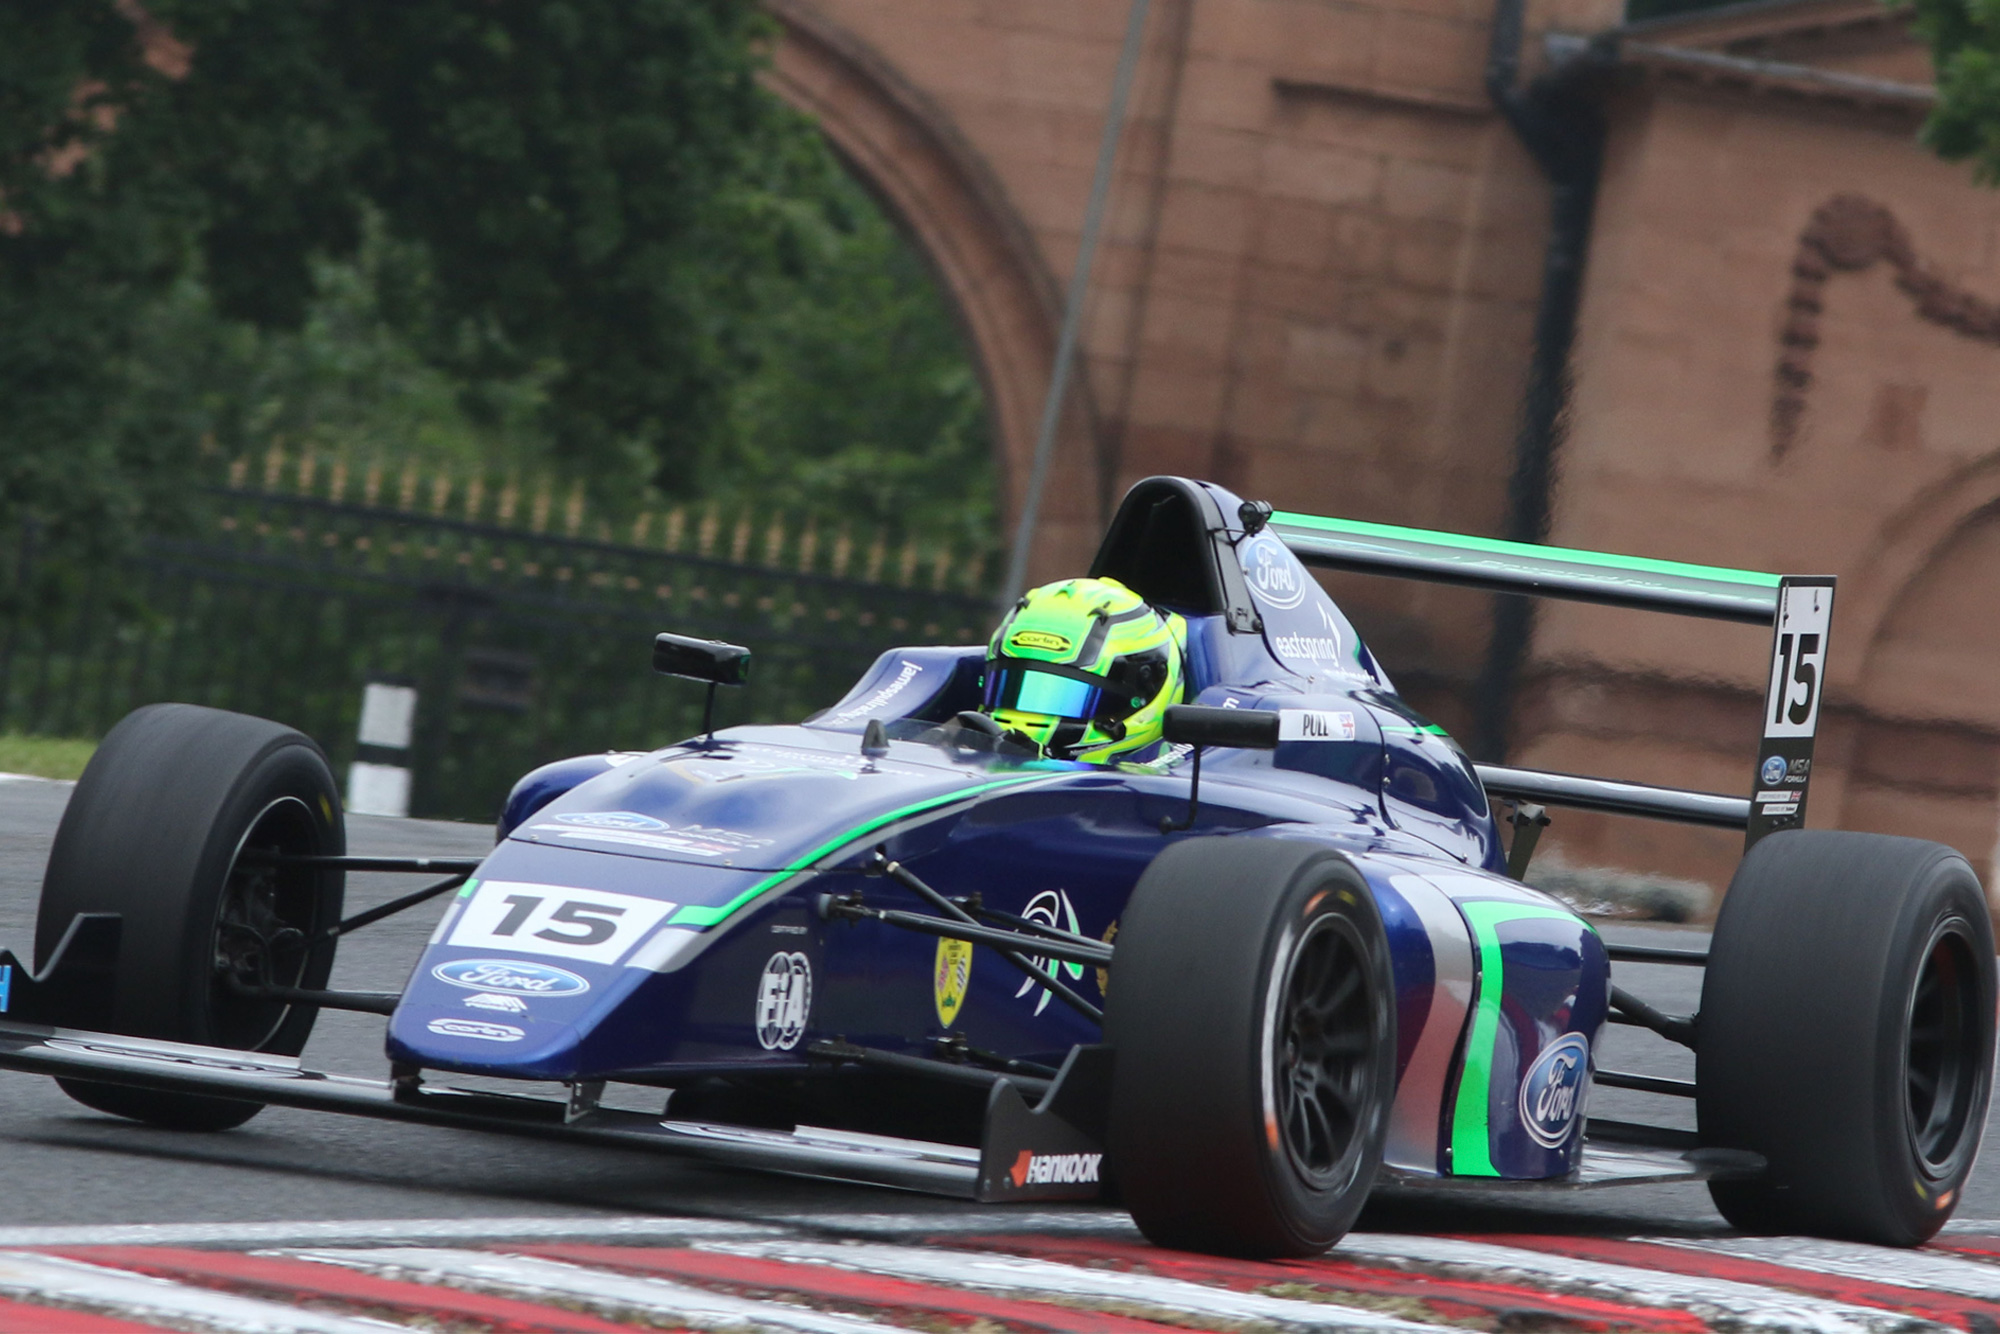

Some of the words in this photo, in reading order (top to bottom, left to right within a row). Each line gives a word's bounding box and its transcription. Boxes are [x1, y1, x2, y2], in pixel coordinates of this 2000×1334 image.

[1256, 543, 1295, 592] Ford
[1275, 631, 1340, 668] eastspring
[1774, 633, 1821, 725] 15
[1302, 713, 1329, 737] PULL
[491, 894, 628, 946] 15
[458, 963, 561, 991] Ford
[1536, 1052, 1582, 1122] Ford
